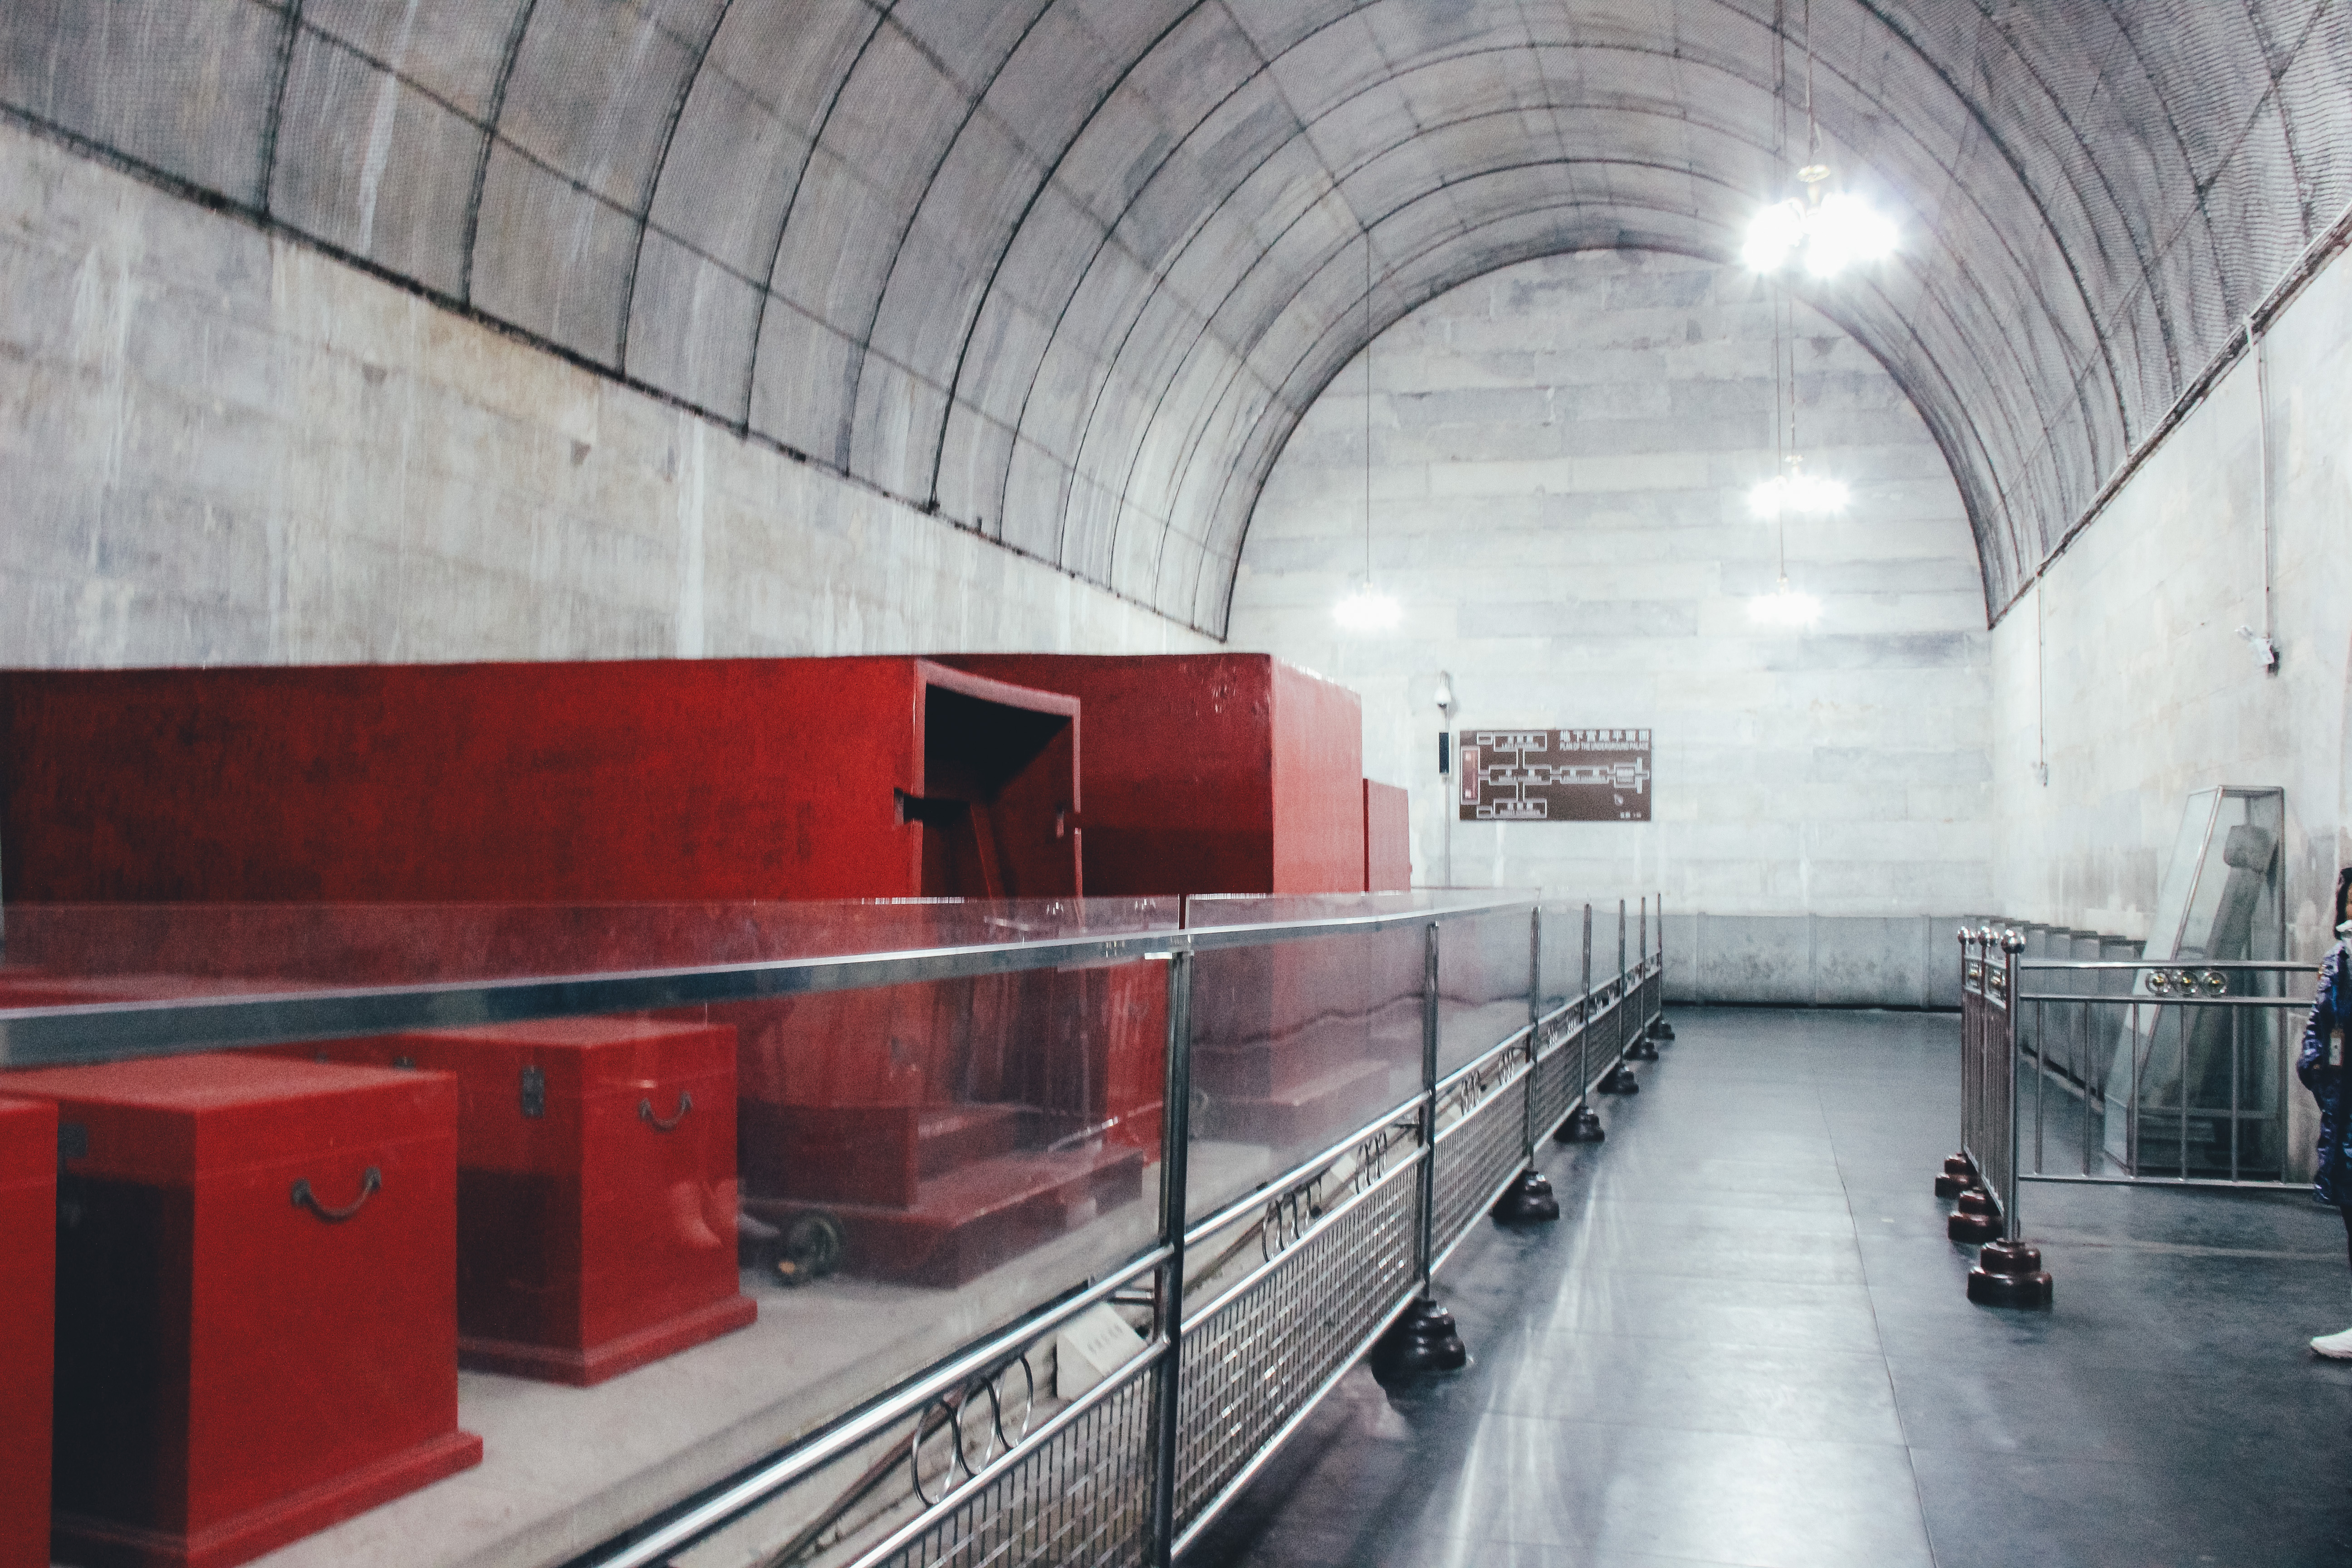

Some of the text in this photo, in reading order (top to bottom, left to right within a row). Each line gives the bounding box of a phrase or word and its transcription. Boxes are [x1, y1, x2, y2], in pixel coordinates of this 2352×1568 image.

[1560, 742, 1649, 750] PLAN OF THE UNDERGROUND PALACE
